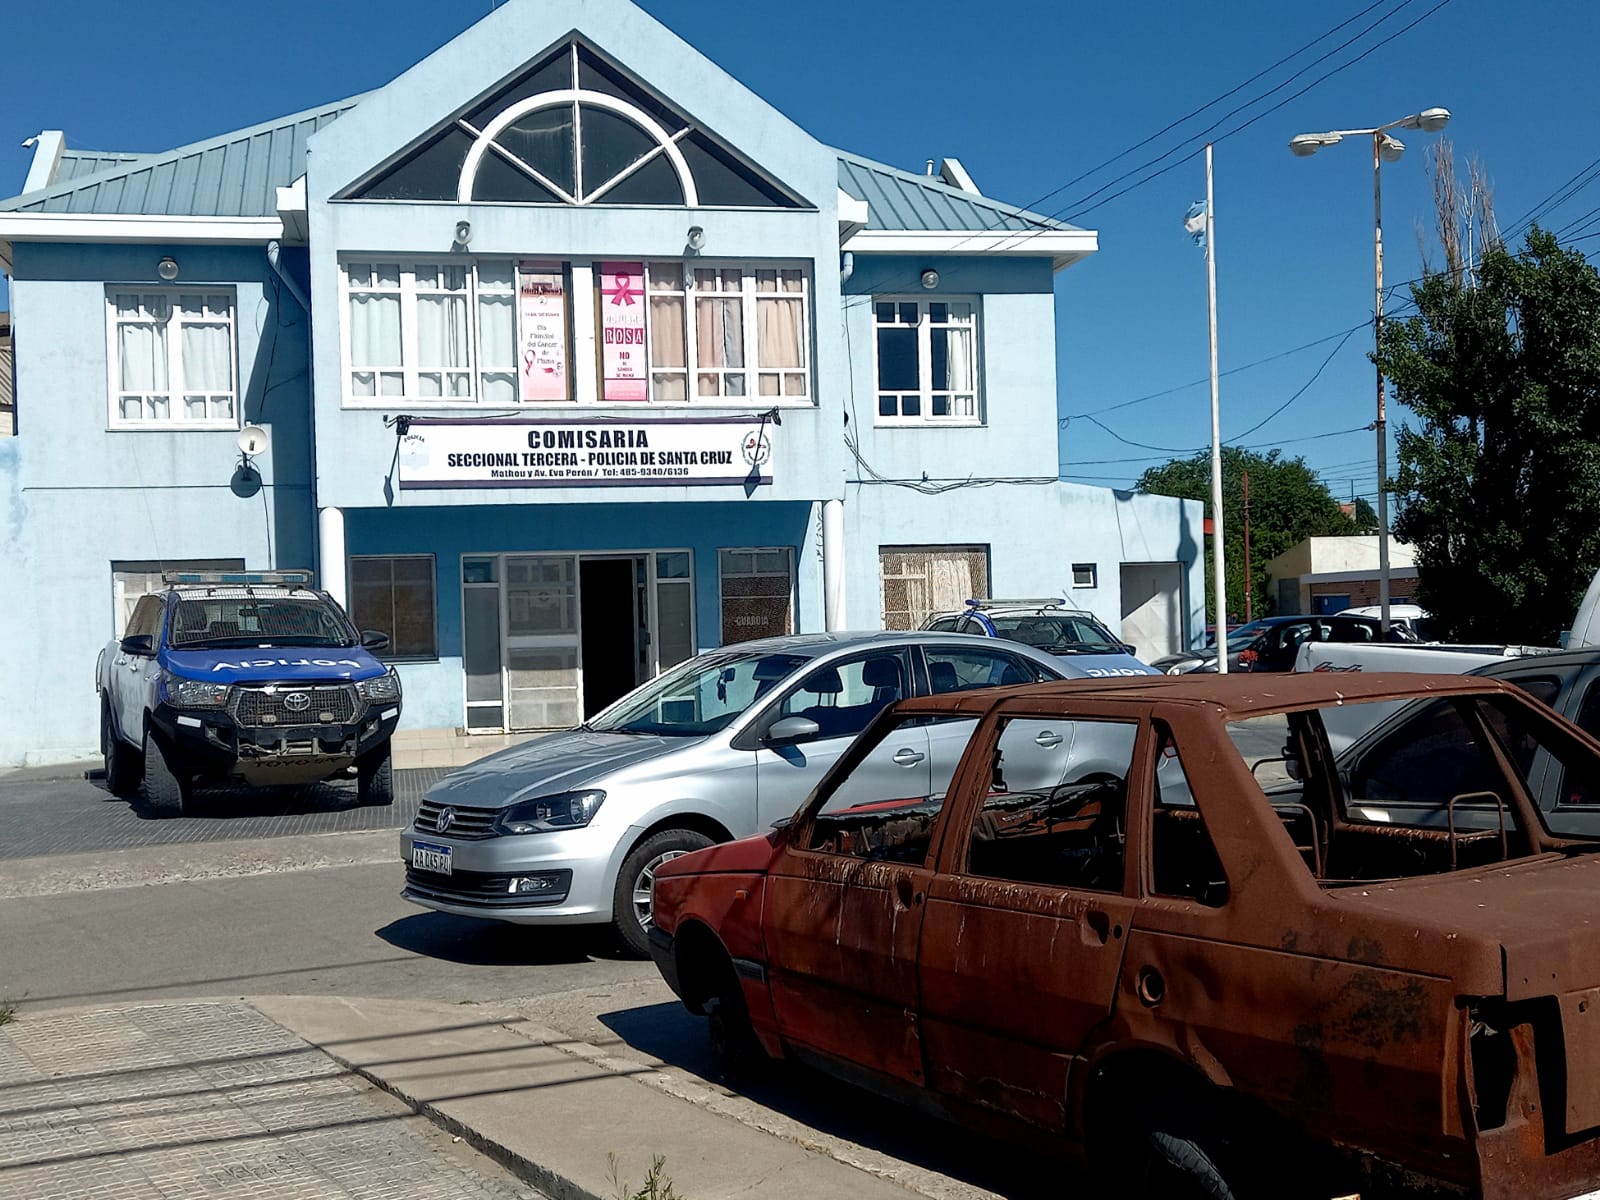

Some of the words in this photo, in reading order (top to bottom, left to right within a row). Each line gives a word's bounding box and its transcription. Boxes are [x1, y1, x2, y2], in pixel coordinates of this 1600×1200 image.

[605, 328, 643, 344] ROSA
[619, 352, 630, 360] NO
[528, 430, 649, 449] COMISARIA
[447, 453, 519, 467] SECCIONAL
[522, 452, 578, 466] TERCERA
[588, 451, 637, 466] POLICIA
[640, 451, 656, 465] DE
[658, 451, 698, 465] SANTA
[700, 451, 732, 464] CRUZ
[534, 469, 547, 477] Av.
[549, 469, 564, 477] Eva
[736, 615, 769, 626] GUARDIA
